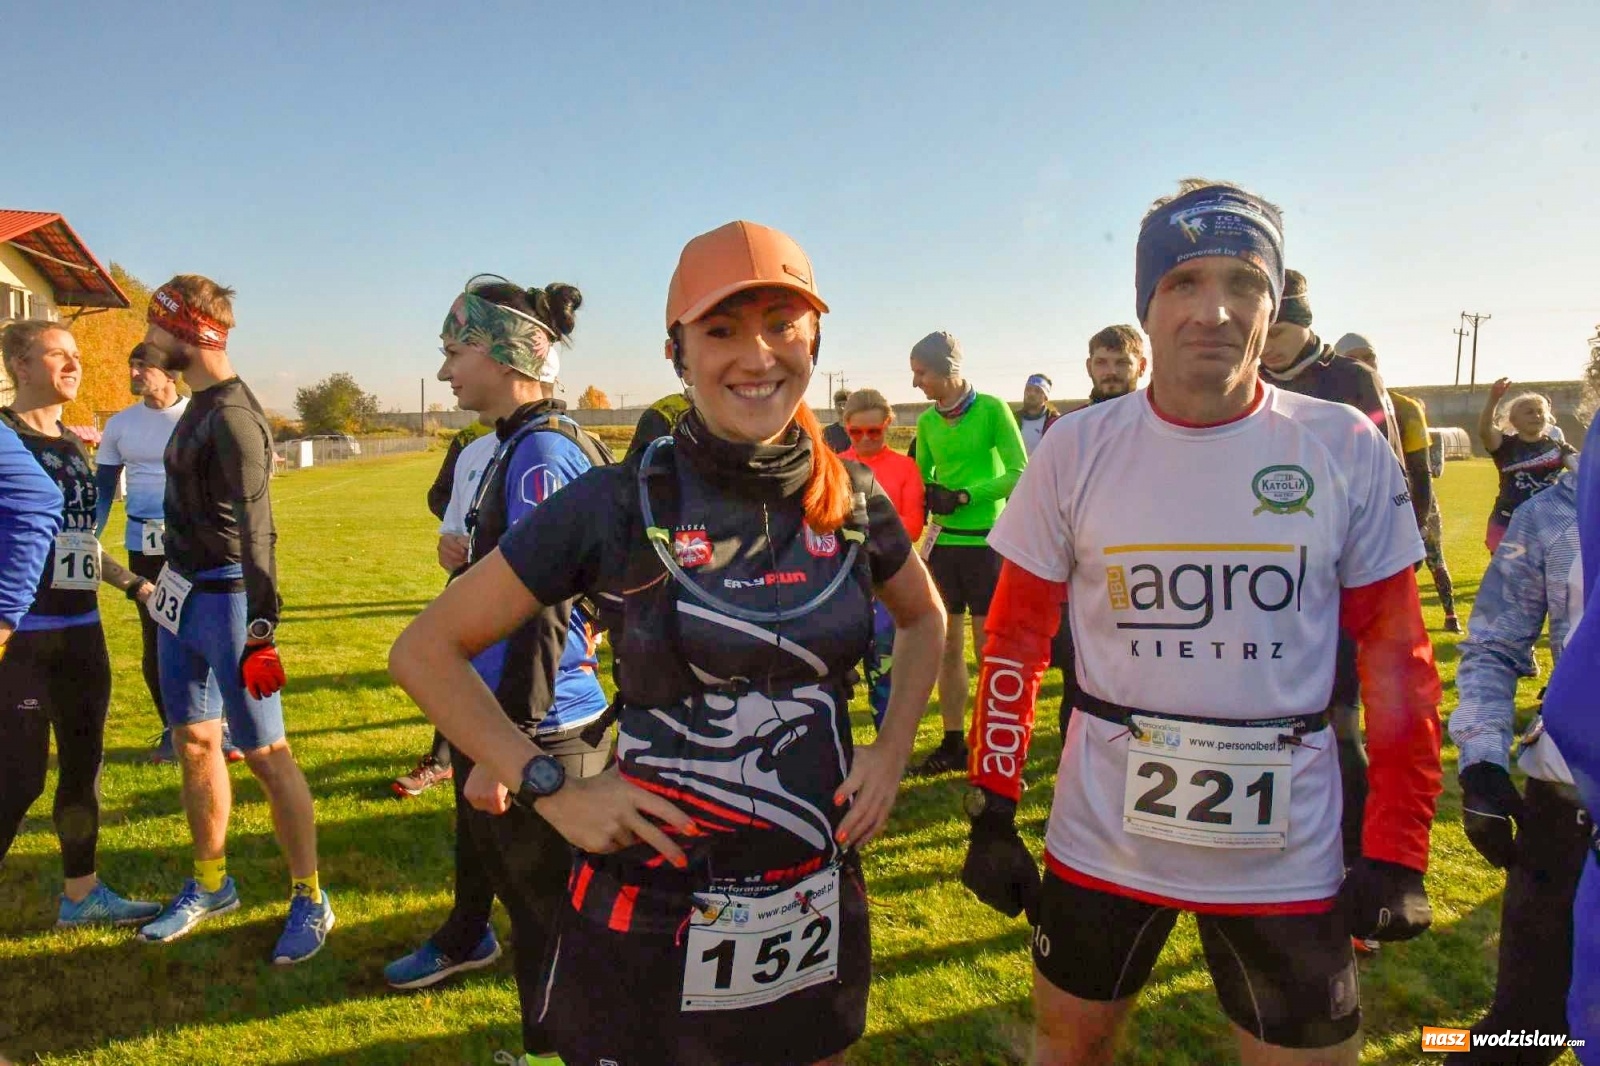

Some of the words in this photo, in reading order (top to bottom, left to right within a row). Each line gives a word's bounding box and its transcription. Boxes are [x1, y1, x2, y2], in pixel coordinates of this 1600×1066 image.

[1223, 247, 1238, 257] by
[157, 291, 180, 313] SKIE
[1107, 567, 1129, 609] HBU
[1117, 545, 1308, 629] agrol
[1131, 639, 1284, 659] KIETRZ
[1134, 761, 1275, 825] 221
[709, 882, 780, 893] performance
[702, 916, 833, 989] 152
